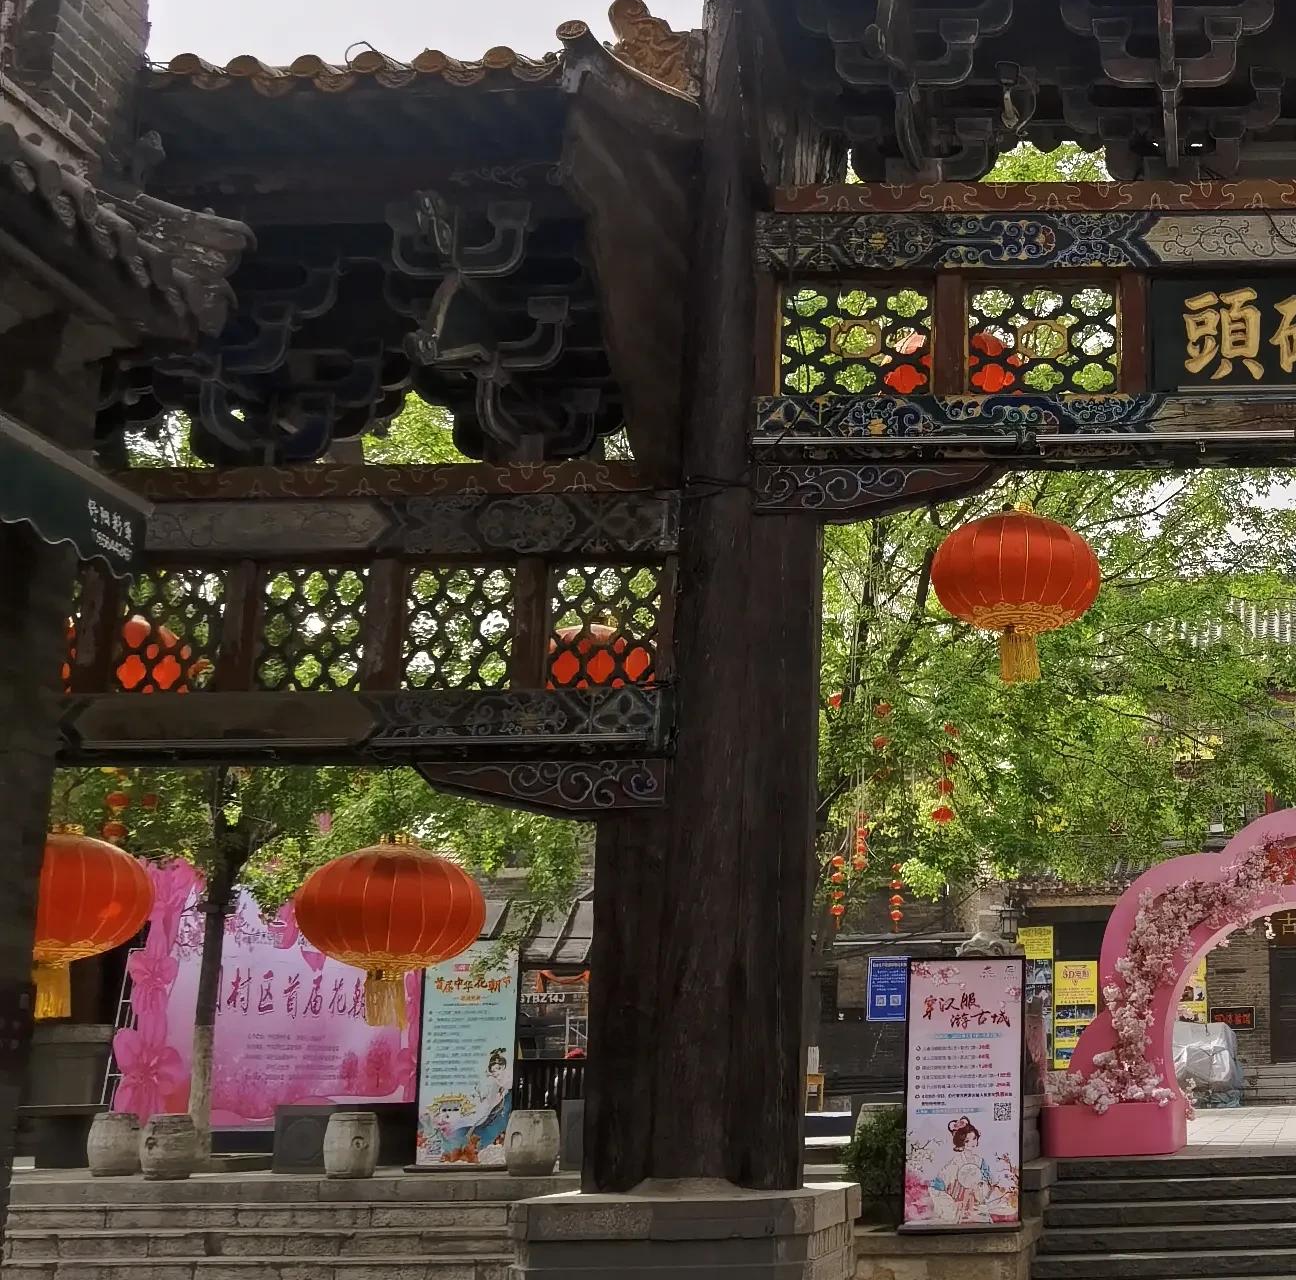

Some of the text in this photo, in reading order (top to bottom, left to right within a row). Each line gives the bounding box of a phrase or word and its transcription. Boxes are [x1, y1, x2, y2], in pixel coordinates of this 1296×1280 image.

[922, 992, 981, 1020] 穿汉服
[950, 1008, 1012, 1030] 游古城
